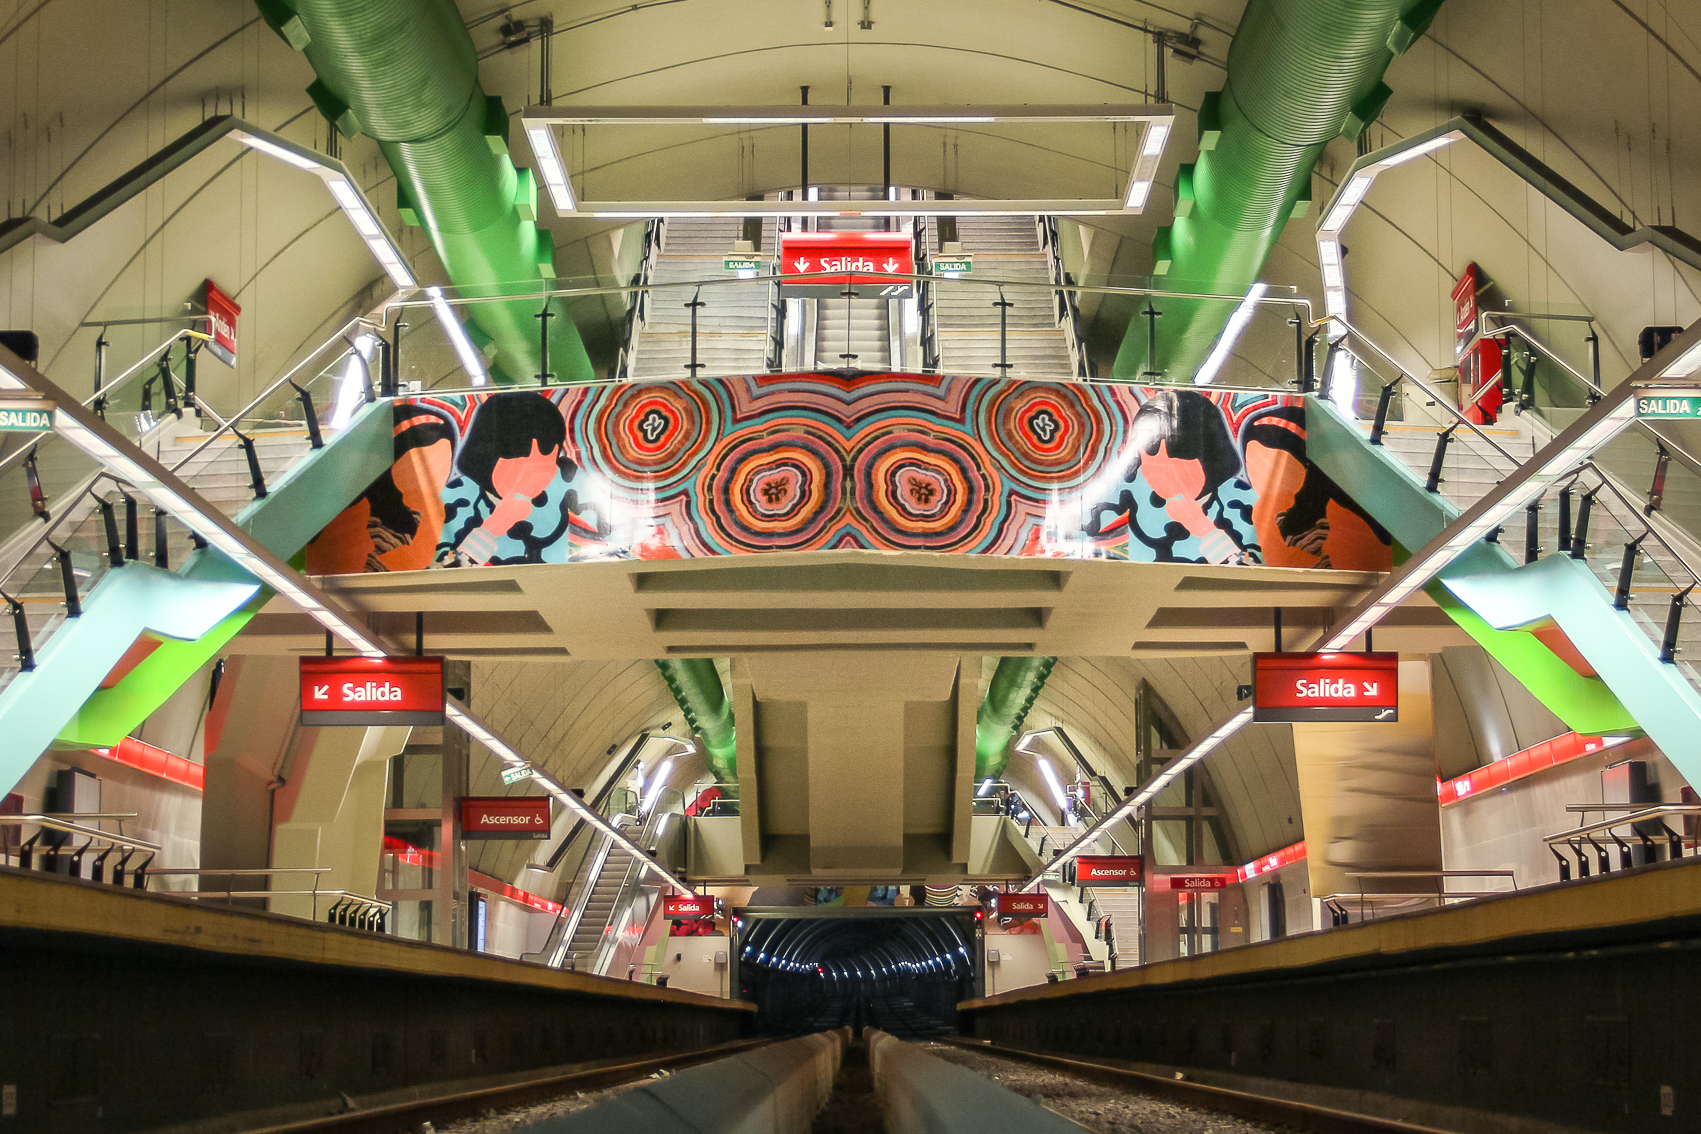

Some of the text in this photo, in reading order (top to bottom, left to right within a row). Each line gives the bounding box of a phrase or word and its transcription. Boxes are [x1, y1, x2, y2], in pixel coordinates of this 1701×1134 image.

[820, 257, 874, 273] Salida
[1639, 399, 1691, 414] SALIDA
[0, 411, 50, 427] SALIDA
[342, 682, 402, 701] Salida
[1295, 678, 1355, 697] Salida
[511, 768, 532, 780] SALIDA
[480, 814, 531, 824] Ascensor
[1090, 868, 1127, 876] Ascensor
[1184, 879, 1211, 887] Salida
[678, 904, 700, 912] Salida
[1012, 902, 1034, 910] Salida
